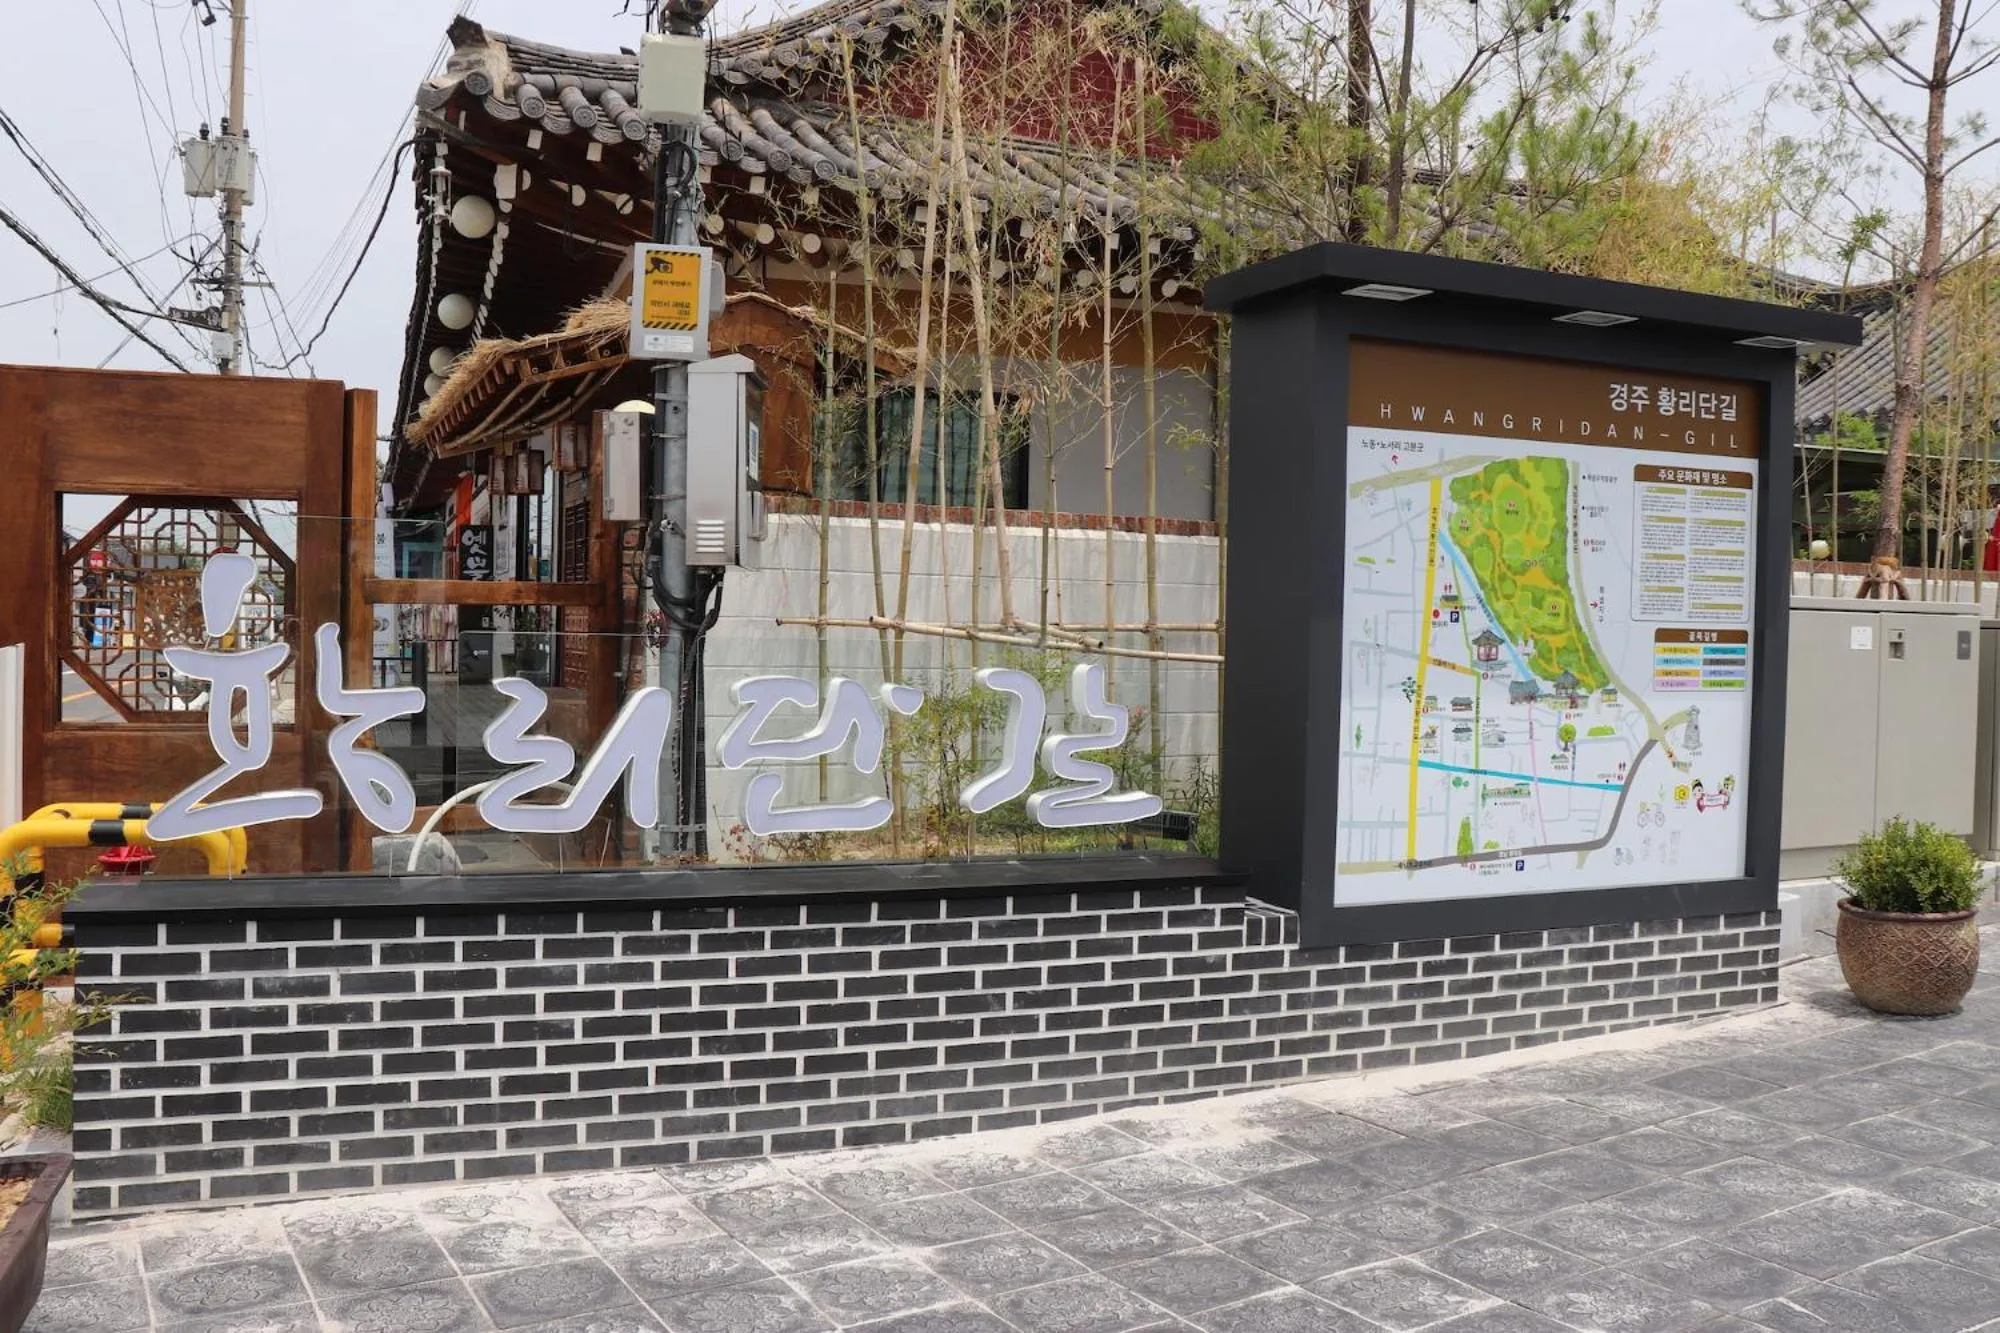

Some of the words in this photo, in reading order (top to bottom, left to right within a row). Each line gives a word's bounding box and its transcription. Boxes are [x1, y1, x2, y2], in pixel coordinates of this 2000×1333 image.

[1609, 383, 1651, 413] 경주
[1656, 387, 1738, 422] 황리단길
[1658, 468, 1675, 481] 주요
[1711, 472, 1728, 485] 명소
[146, 553, 1163, 840] 황리단길
